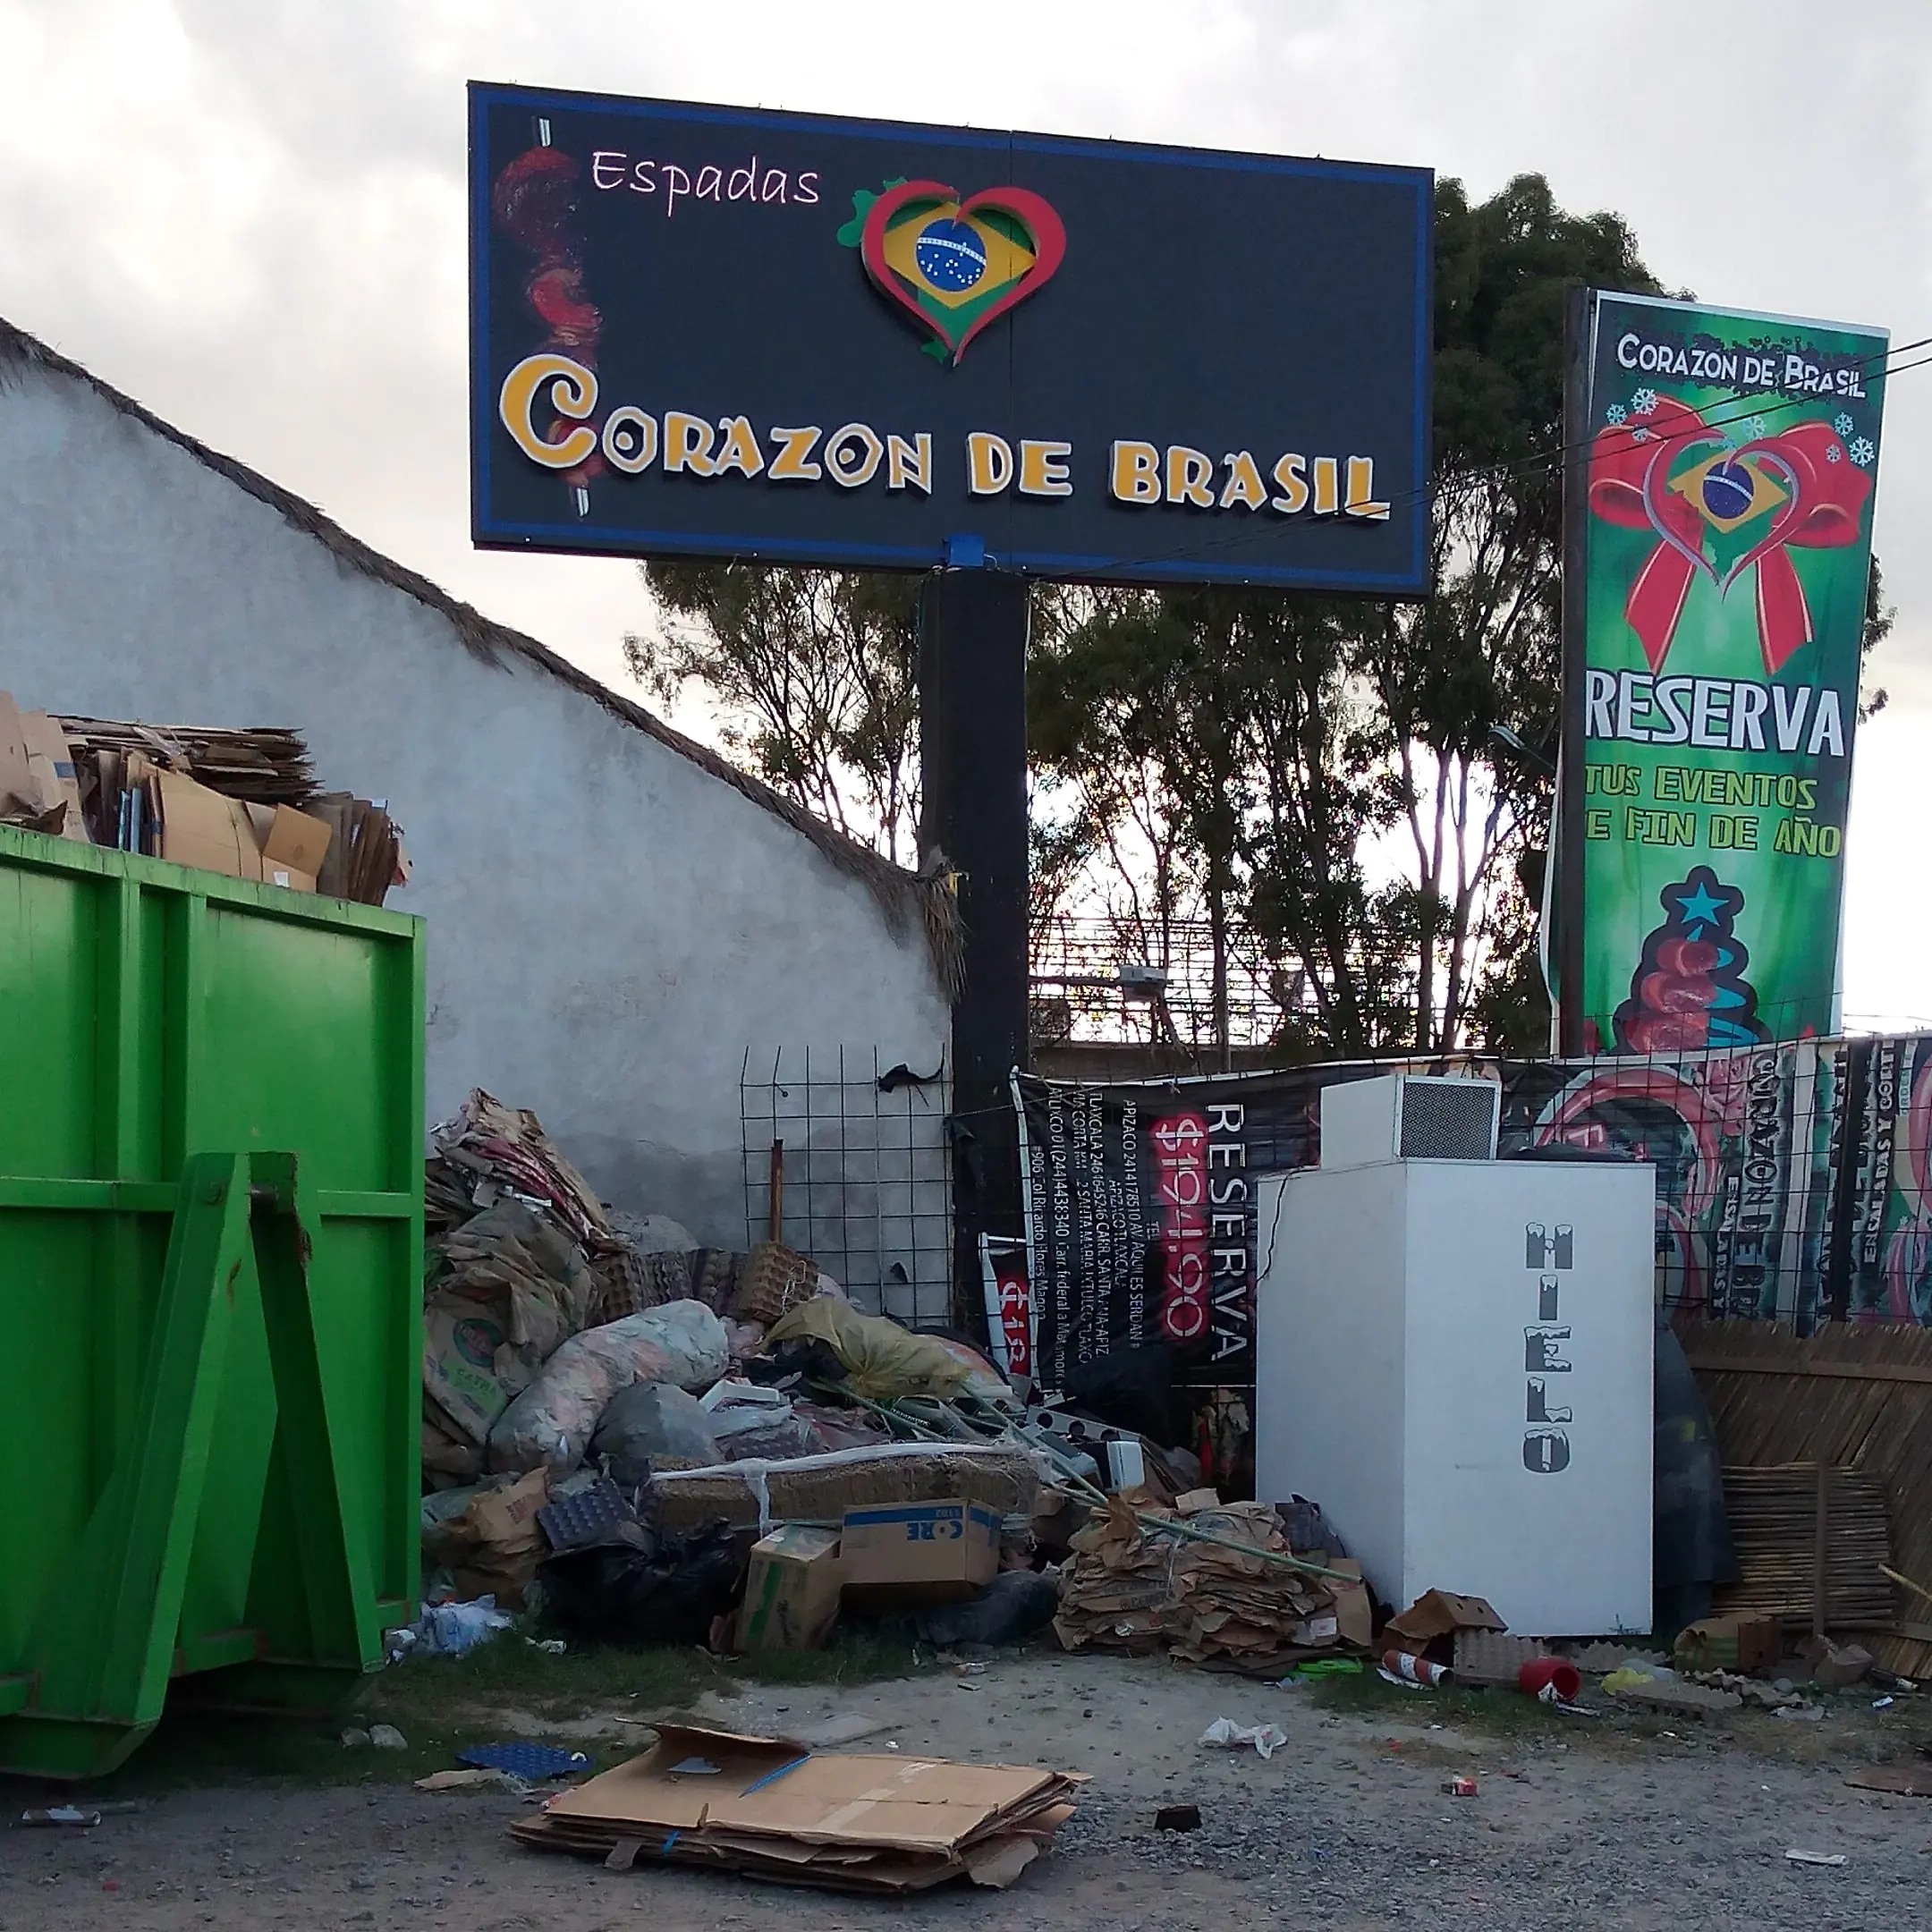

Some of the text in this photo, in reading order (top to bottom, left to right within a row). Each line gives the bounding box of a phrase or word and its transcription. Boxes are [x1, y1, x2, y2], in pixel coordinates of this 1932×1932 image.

[591, 148, 822, 218] Espadas
[1616, 332, 1867, 399] CORAZON DE BRASIL
[498, 352, 1392, 522] CORAZON DE BRASIL
[1584, 669, 1844, 758] RESERVA
[1584, 764, 1818, 810] TUS EVENTOS
[1626, 808, 1696, 846] FIN
[1709, 815, 1758, 850] DE
[1773, 815, 1842, 858] AÑO
[1122, 1099, 1137, 1151] APIZACO
[1123, 1152, 1140, 1221] 2414178510
[1863, 1137, 1893, 1264] ENSALADAS
[1205, 1103, 1248, 1361] RESERVA
[1097, 1258, 1111, 1297] SANTA
[1129, 1292, 1144, 1341] SERDAN
[1522, 1221, 1573, 1474] HIELO
